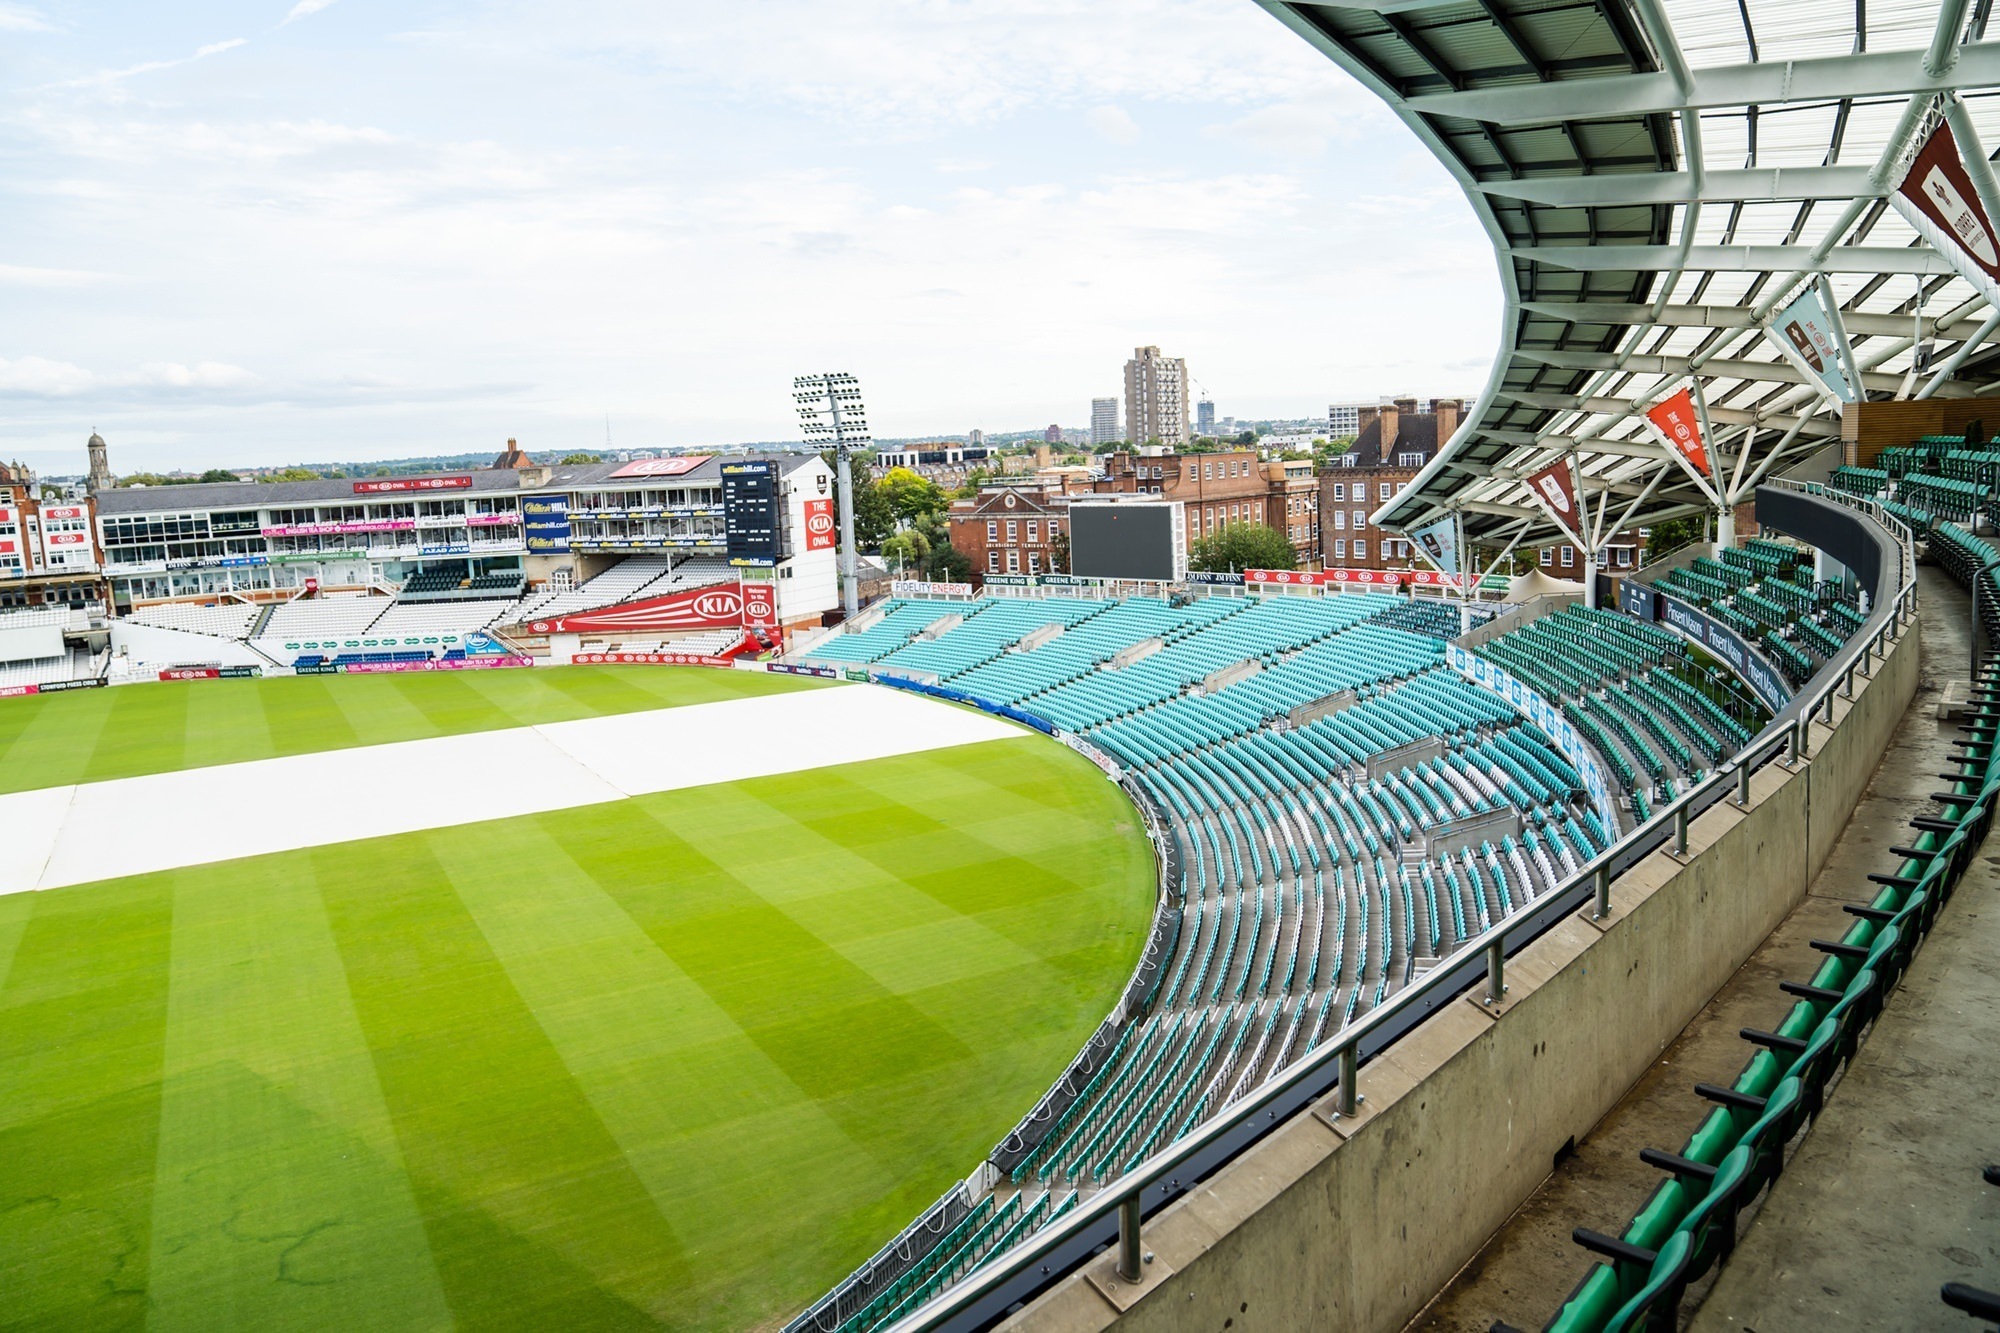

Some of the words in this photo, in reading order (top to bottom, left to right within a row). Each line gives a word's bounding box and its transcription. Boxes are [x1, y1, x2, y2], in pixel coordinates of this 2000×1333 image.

[1954, 210, 1976, 238] SURREY
[1667, 411, 1680, 424] THE
[1683, 439, 1698, 452] OVAL
[642, 462, 678, 470] KIA
[722, 465, 766, 473] williamhill.com
[812, 502, 826, 511] THE
[812, 518, 830, 530] KIA
[812, 536, 830, 546] OVAL
[895, 582, 931, 592] FIDELITY
[932, 584, 967, 594] ENERGY
[702, 597, 737, 612] KIA
[751, 604, 767, 614] KIA
[1668, 602, 1685, 626] Pinsent
[1685, 612, 1703, 637] Masons
[1709, 625, 1727, 652] Pinsent
[1726, 637, 1742, 668] Masons
[1748, 655, 1764, 688] Pinsent
[1764, 671, 1779, 708] Masons
